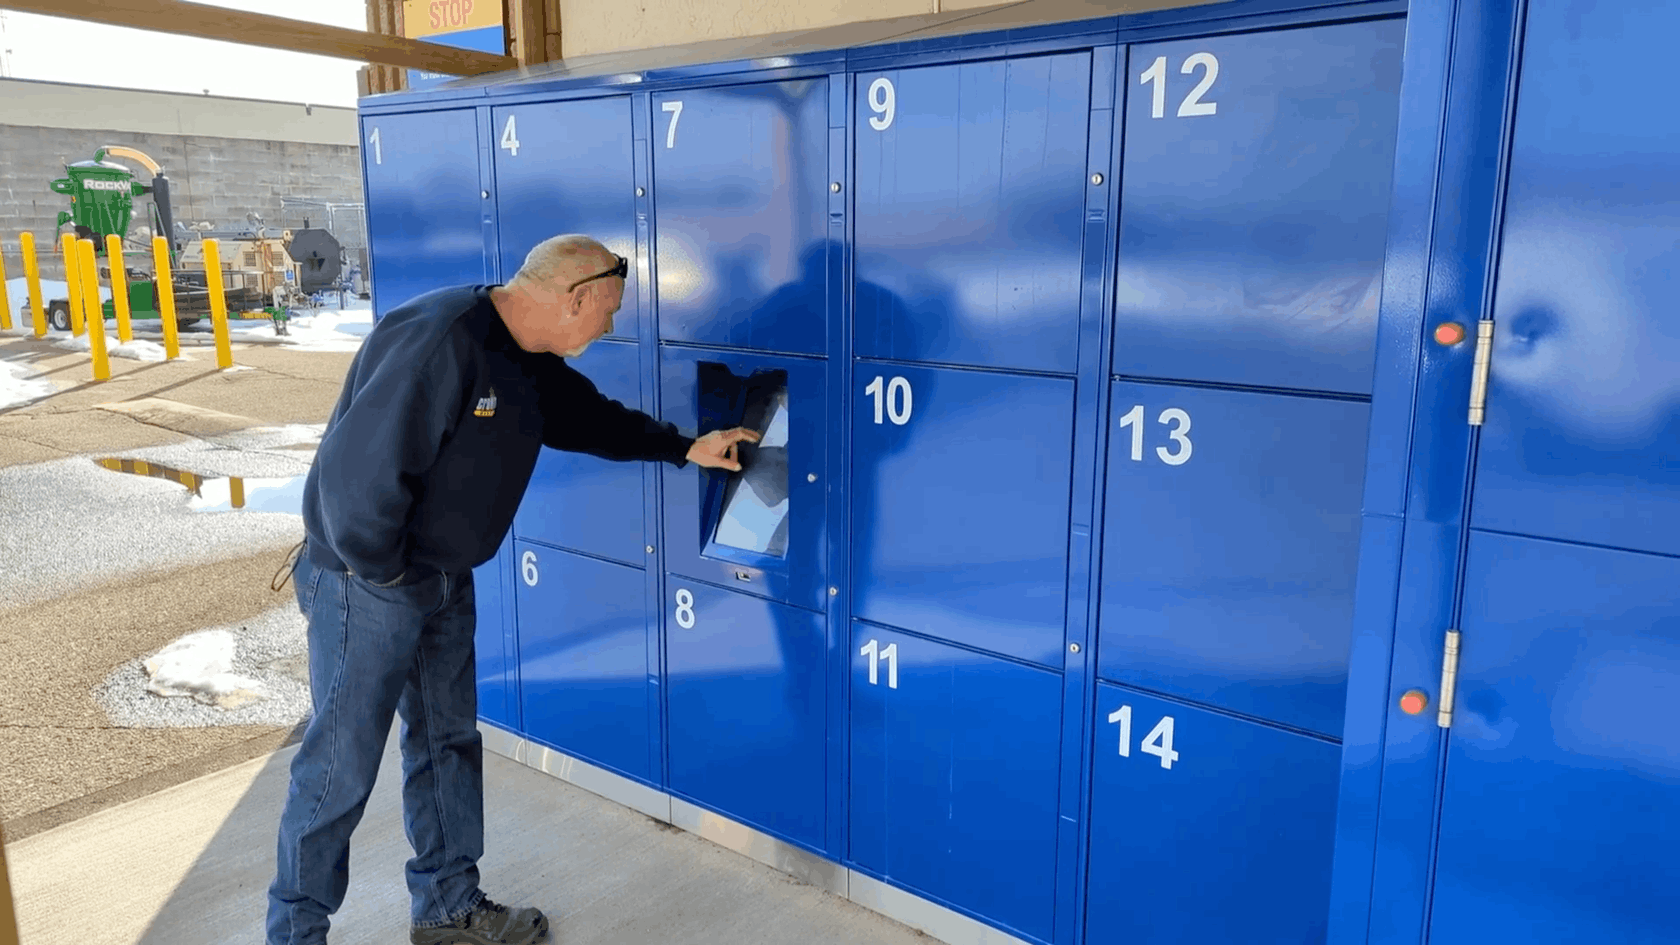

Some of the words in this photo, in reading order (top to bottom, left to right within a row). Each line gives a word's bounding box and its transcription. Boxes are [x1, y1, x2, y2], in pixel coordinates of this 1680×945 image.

[429, 0, 473, 29] STOP
[868, 77, 895, 131] 9
[1140, 52, 1219, 119] 12
[368, 127, 382, 165] 1
[500, 115, 520, 156] 4
[662, 101, 683, 149] 7
[865, 375, 913, 426] 10
[1120, 405, 1193, 466] 13
[521, 551, 539, 587] 6
[675, 588, 695, 629] 8
[860, 639, 898, 689] 11
[1108, 704, 1179, 770] 14
